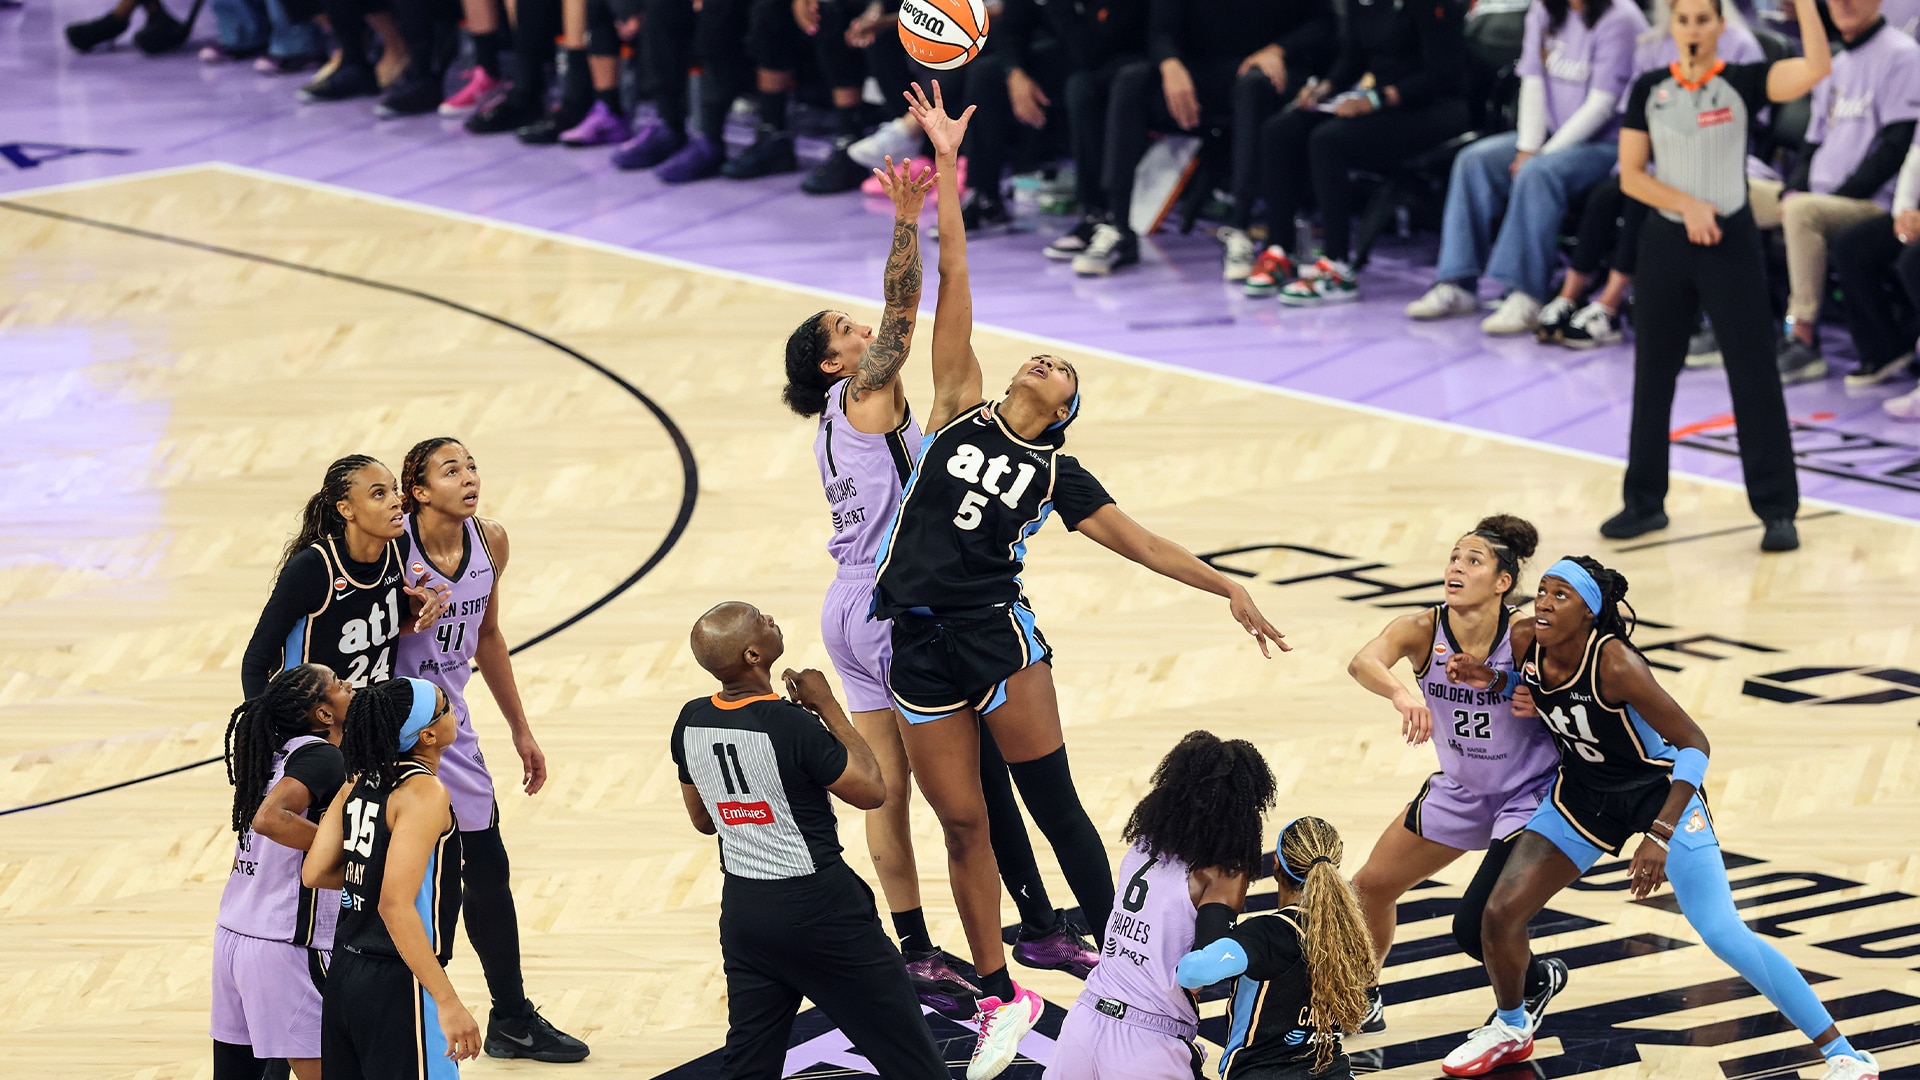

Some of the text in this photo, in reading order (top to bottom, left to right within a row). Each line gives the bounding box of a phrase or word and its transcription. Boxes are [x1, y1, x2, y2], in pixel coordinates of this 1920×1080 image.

[903, 1, 945, 37] Wilson
[824, 419, 838, 478] 1
[1026, 450, 1050, 469] Albert
[946, 443, 1037, 510] atl
[844, 507, 866, 527] AT&T
[952, 490, 990, 531] 5
[338, 587, 400, 654] atl
[436, 621, 466, 654] 41
[344, 646, 391, 689] 24
[1428, 682, 1474, 705] GOLDEN
[1569, 692, 1592, 702] Albert
[1453, 709, 1492, 739] 22
[712, 742, 751, 795] 11
[1467, 753, 1508, 761] PERMANENTE
[343, 797, 380, 859] 15
[722, 806, 767, 820] Emirates
[1122, 857, 1161, 914] 6
